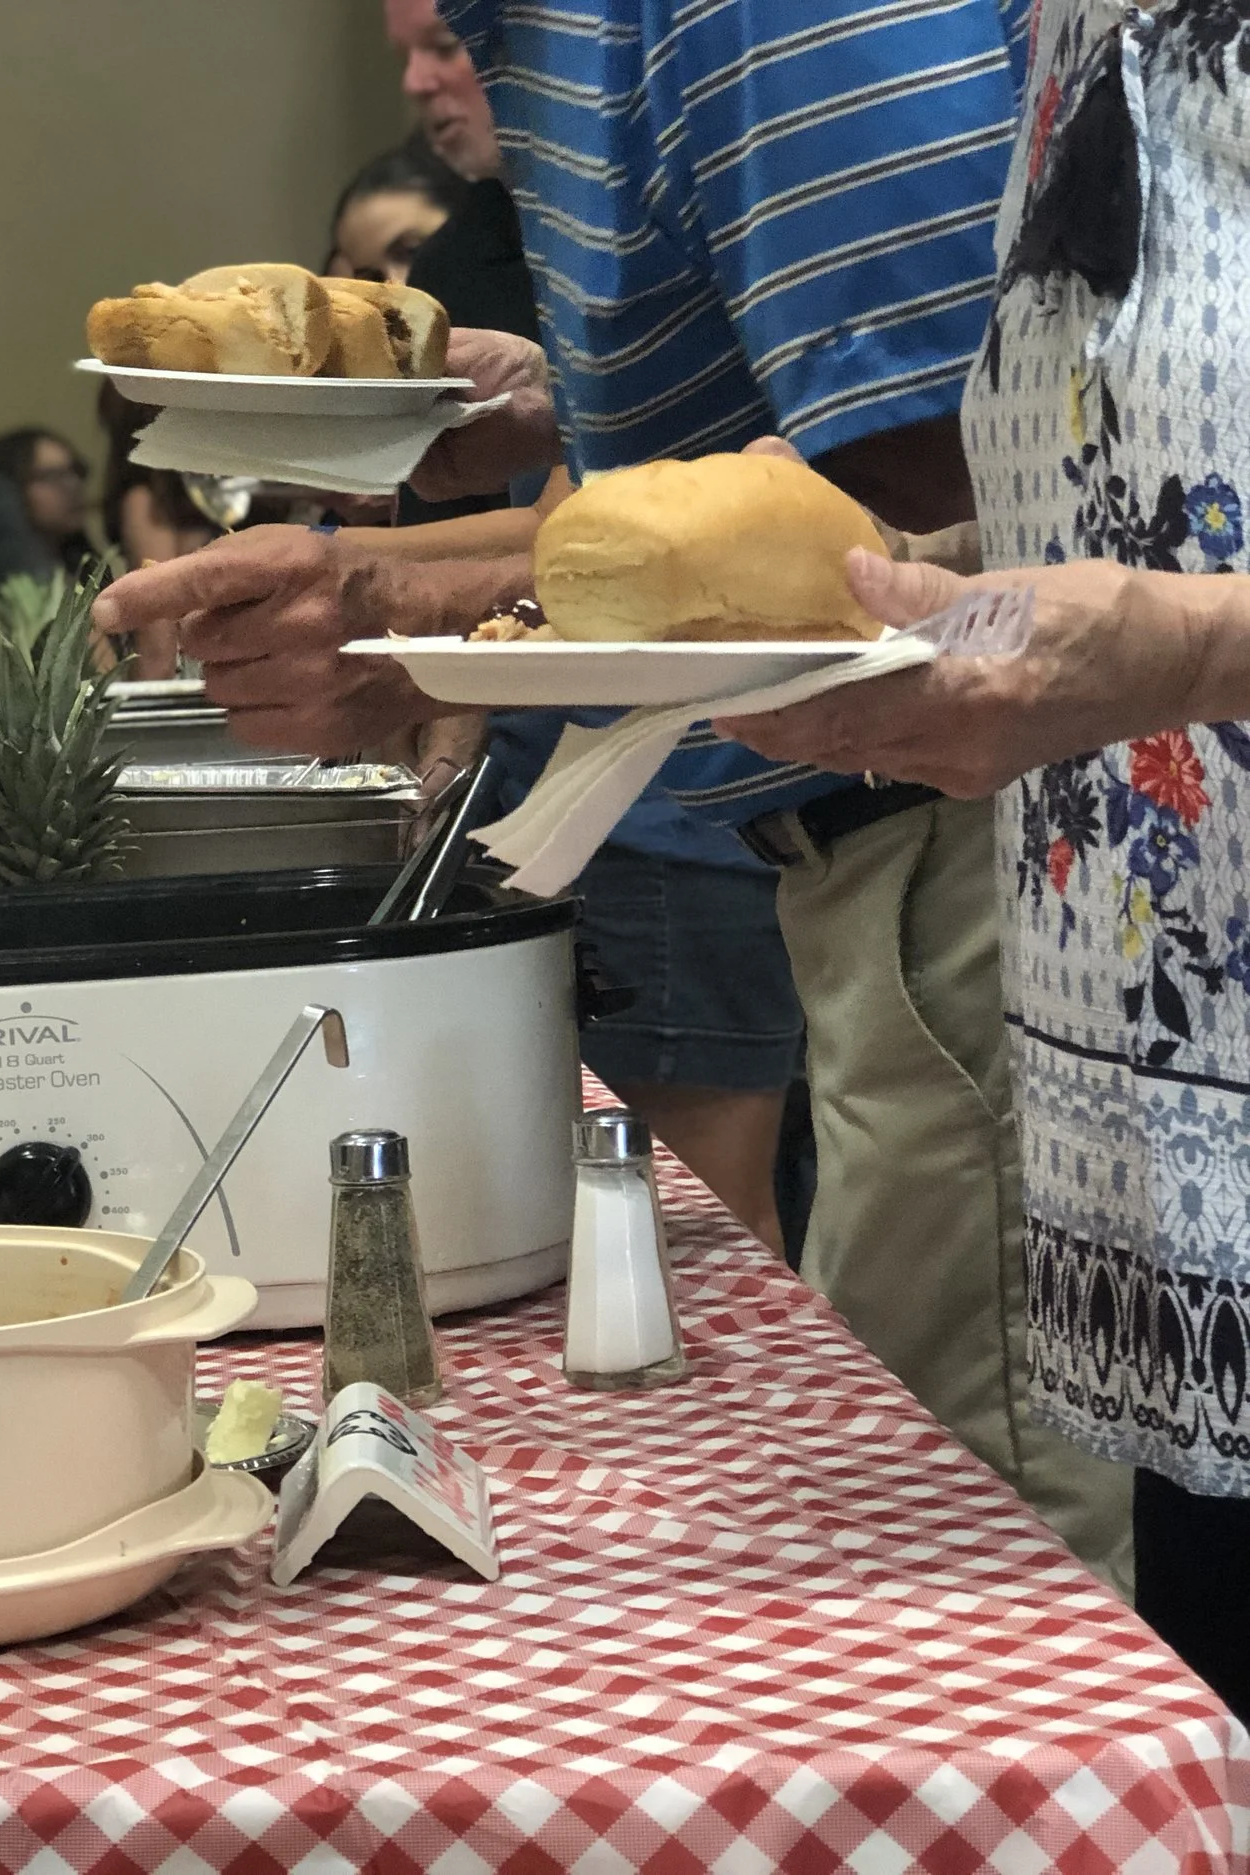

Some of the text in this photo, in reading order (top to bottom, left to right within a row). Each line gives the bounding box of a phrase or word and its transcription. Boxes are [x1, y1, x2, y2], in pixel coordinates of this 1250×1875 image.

[24, 1053, 65, 1066] Quart
[50, 1070, 100, 1088] Oven
[47, 1117, 66, 1126] 250
[86, 1133, 105, 1142] 300
